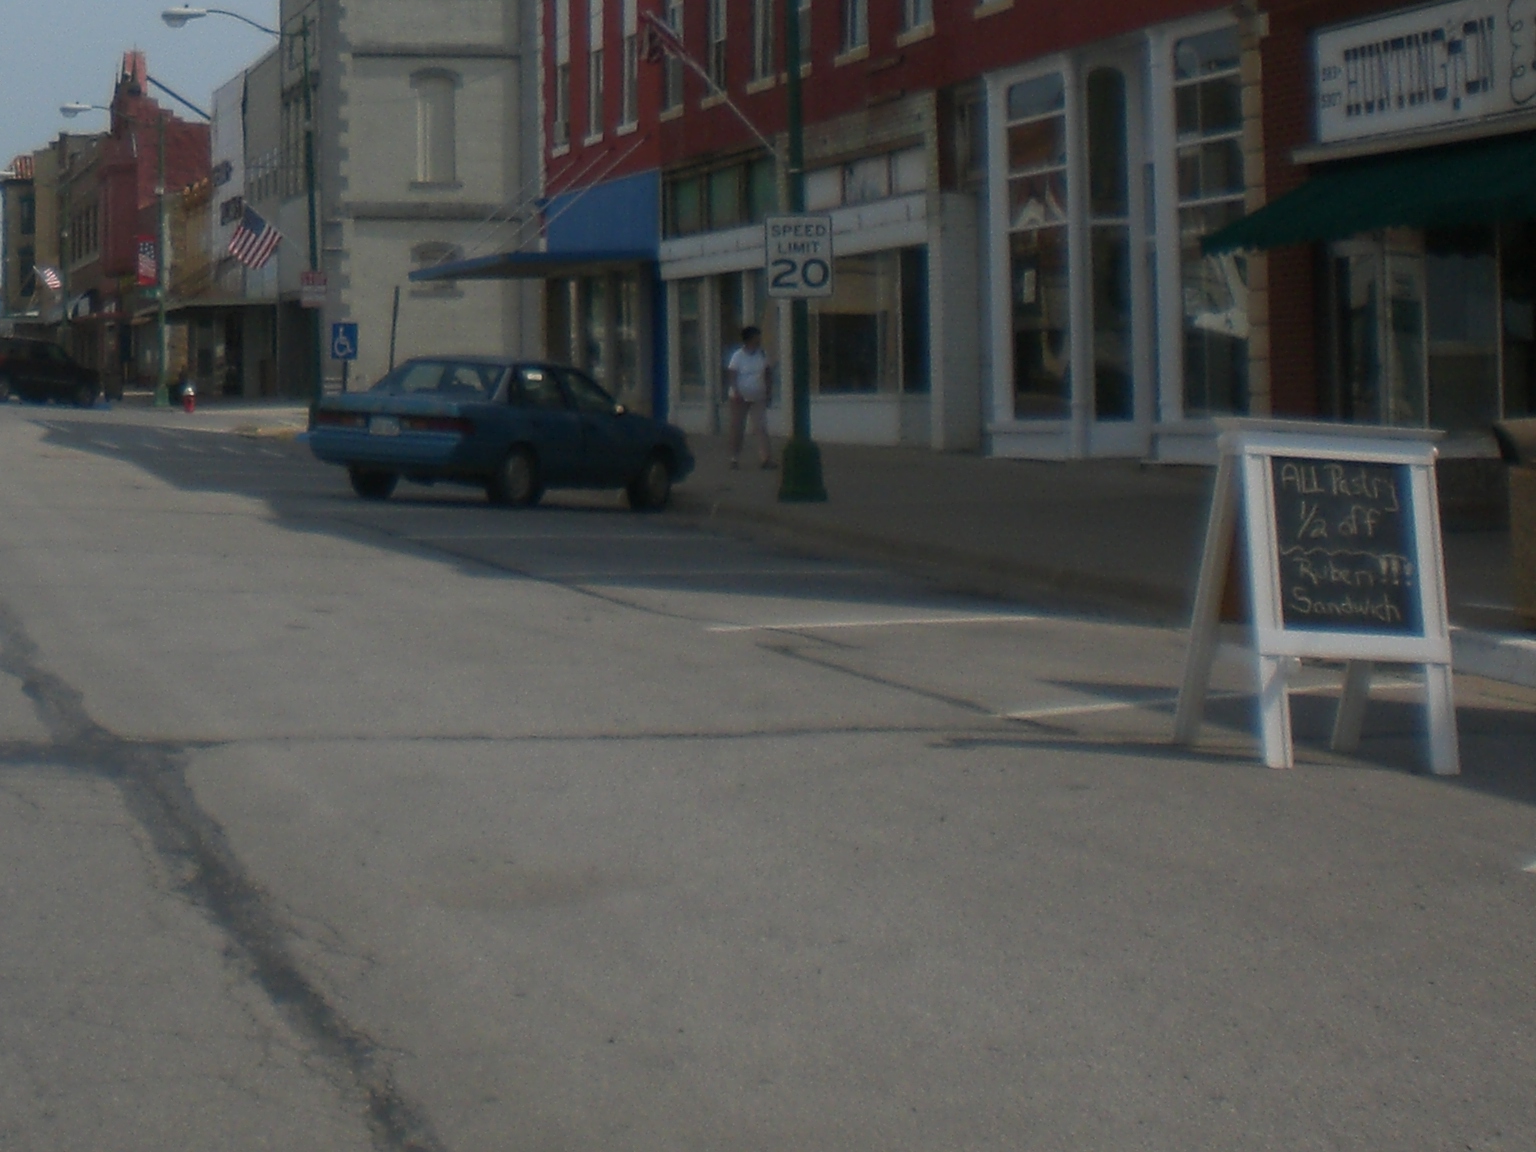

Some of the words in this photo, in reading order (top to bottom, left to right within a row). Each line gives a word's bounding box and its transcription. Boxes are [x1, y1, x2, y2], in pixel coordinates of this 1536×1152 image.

[771, 224, 826, 237] SPEED
[777, 240, 820, 254] LIMIT
[771, 258, 830, 288] 20
[1324, 463, 1399, 512] Pastry
[1338, 505, 1381, 538] off
[1291, 586, 1402, 622] Sandwich
